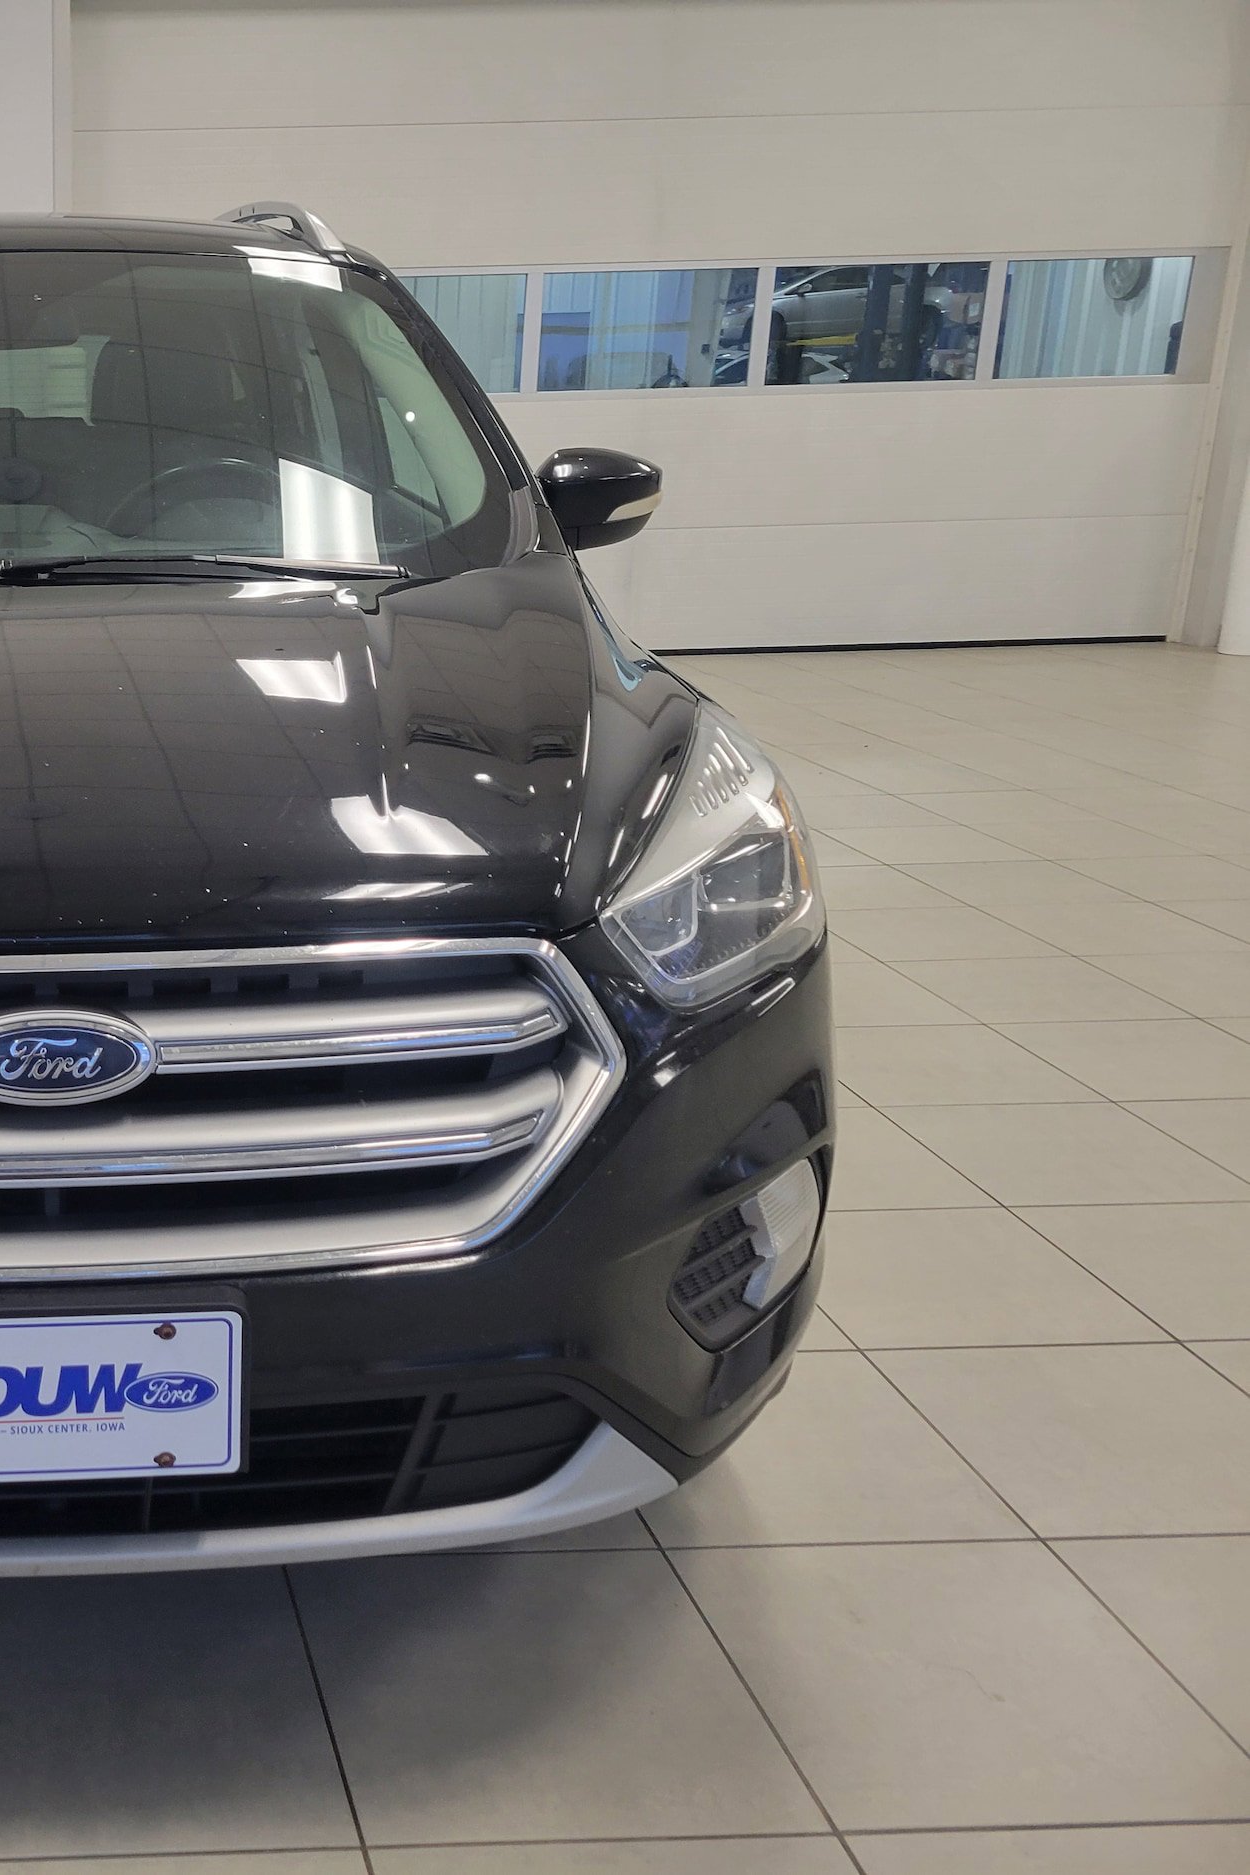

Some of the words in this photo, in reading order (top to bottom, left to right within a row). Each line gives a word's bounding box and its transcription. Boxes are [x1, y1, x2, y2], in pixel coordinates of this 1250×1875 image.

[0, 1037, 104, 1081] Ford
[143, 1377, 198, 1404] Ford
[10, 1425, 44, 1435] SIOUX
[96, 1422, 126, 1432] IOWA
